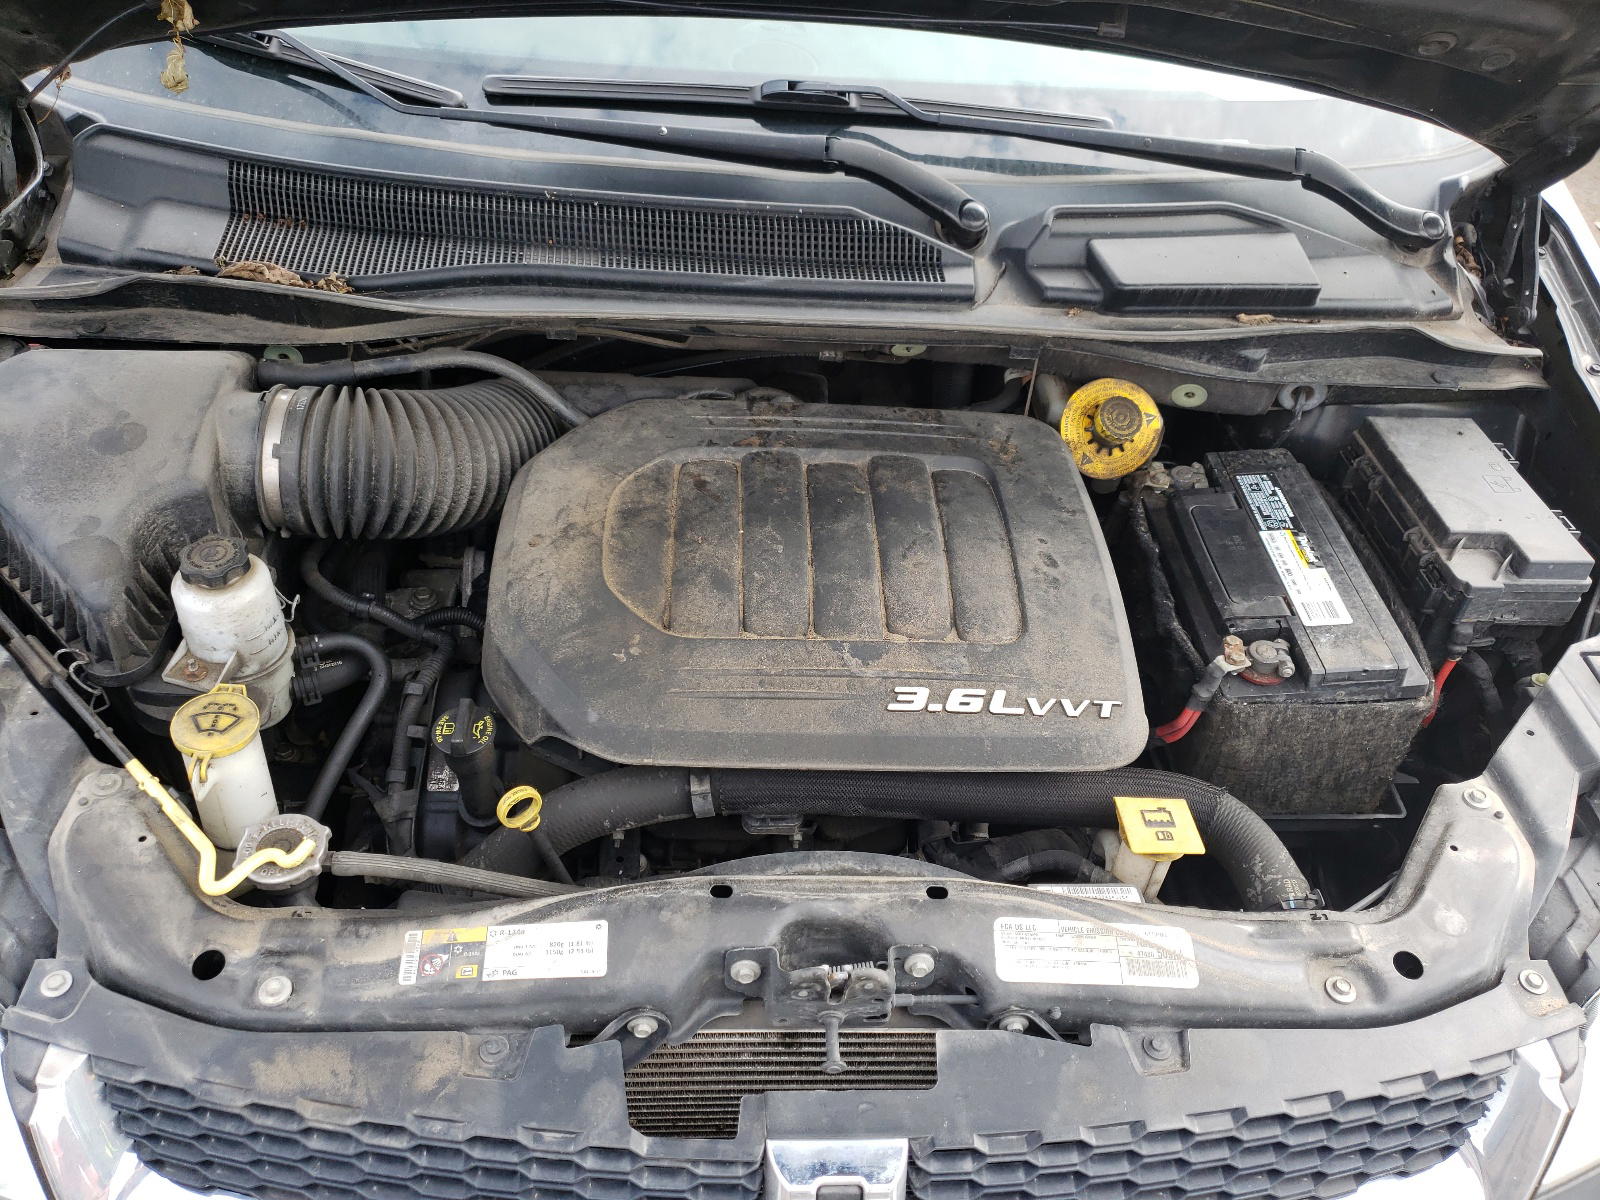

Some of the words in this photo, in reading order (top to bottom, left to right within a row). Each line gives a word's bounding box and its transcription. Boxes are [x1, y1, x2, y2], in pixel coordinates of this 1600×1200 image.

[1026, 697, 1122, 718] VVT
[477, 735, 489, 745] OIL
[502, 969, 518, 977] PAG
